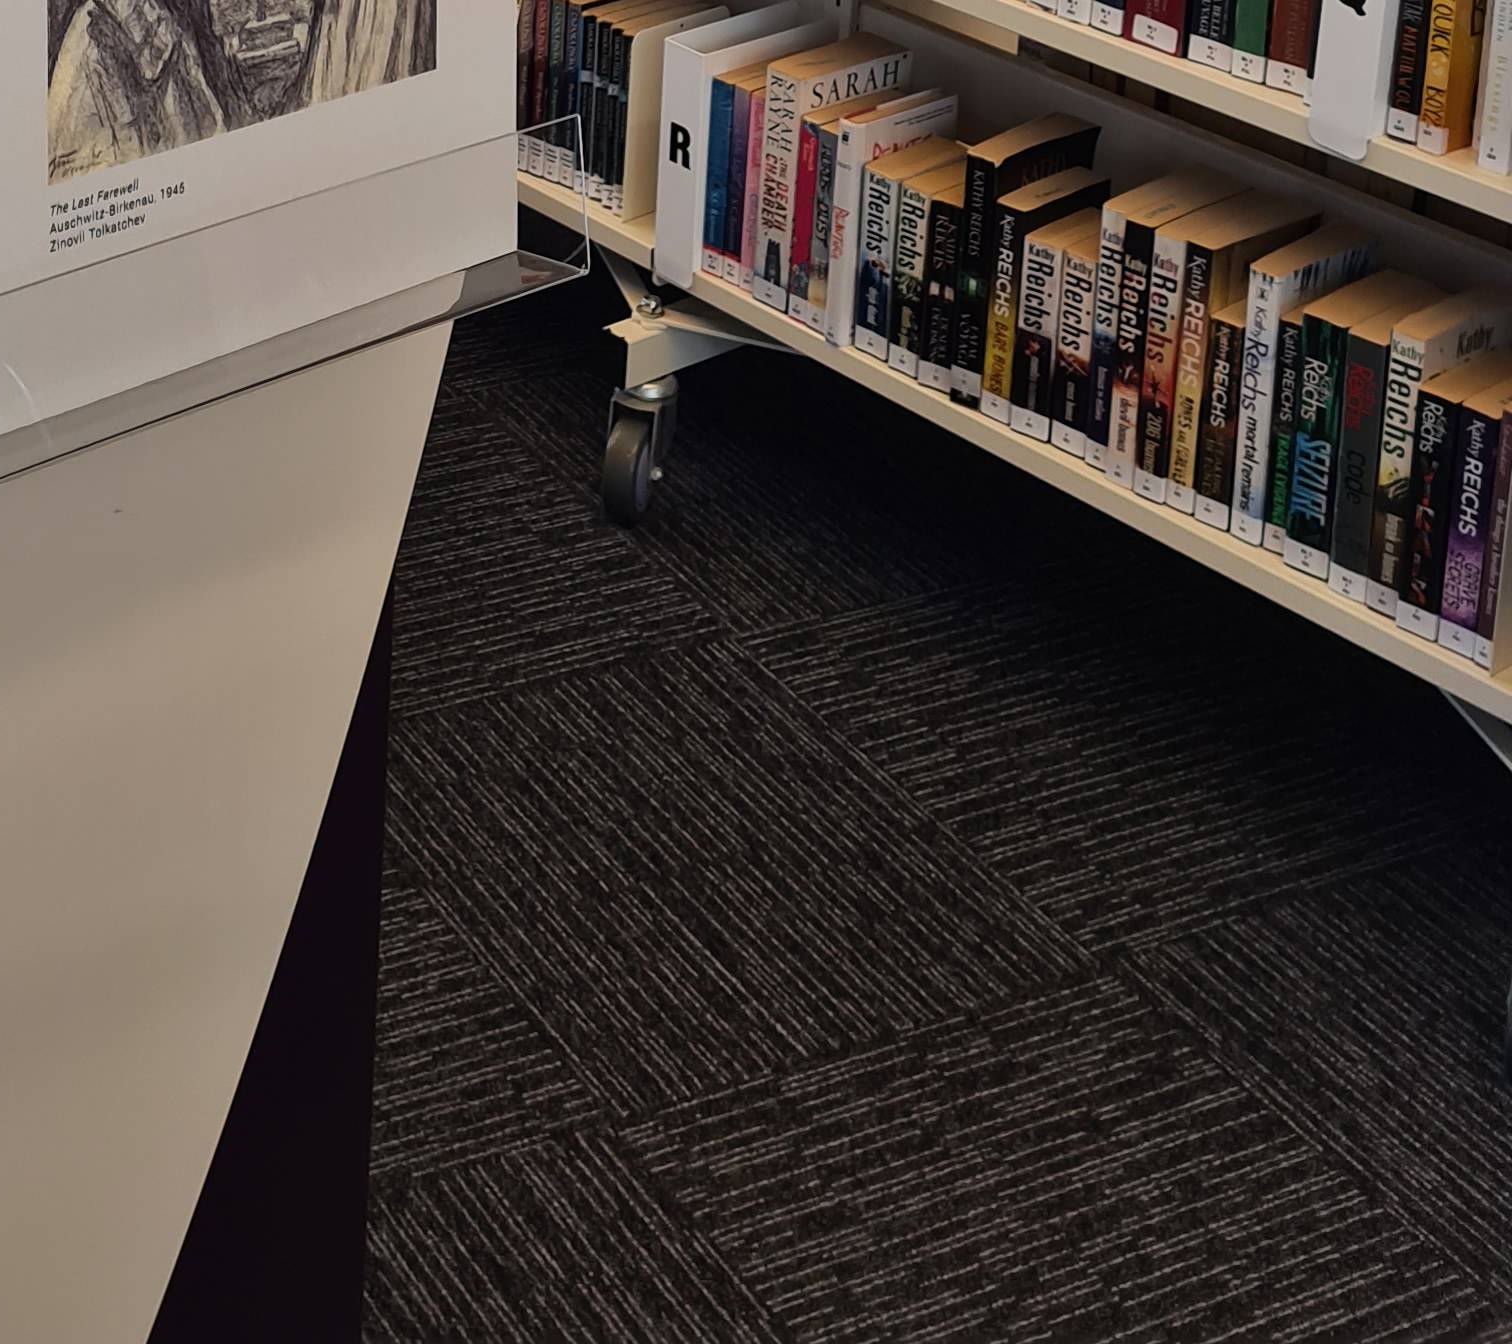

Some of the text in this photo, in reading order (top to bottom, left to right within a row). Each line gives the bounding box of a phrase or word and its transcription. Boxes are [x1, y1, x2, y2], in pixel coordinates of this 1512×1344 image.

[1430, 1, 1457, 60] QUICK
[778, 78, 797, 154] SARAH
[810, 59, 901, 110] SARAH
[669, 120, 692, 171] R
[50, 177, 139, 217] The Last Farewell
[771, 180, 790, 233] DEATH
[865, 185, 891, 256] Reichs
[897, 196, 926, 273] Reichs
[994, 213, 1016, 318] Kathy REICHS
[1028, 242, 1055, 265] Kathy
[1065, 255, 1094, 277] Kathy
[1095, 244, 1124, 328] Reichs
[1023, 256, 1055, 333] Reichs
[1061, 270, 1094, 353] Reichs
[1117, 269, 1147, 355] Reichs
[1146, 270, 1178, 366] Reichs
[1177, 253, 1208, 389] Kathy REICHS
[1392, 338, 1424, 365] Kathy
[1210, 357, 1230, 428] REICHS
[1300, 356, 1329, 426] Reichs
[1383, 357, 1422, 461] Reichs
[1291, 438, 1331, 528] SEIZURE
[1458, 418, 1487, 539] Kathy REICHS
